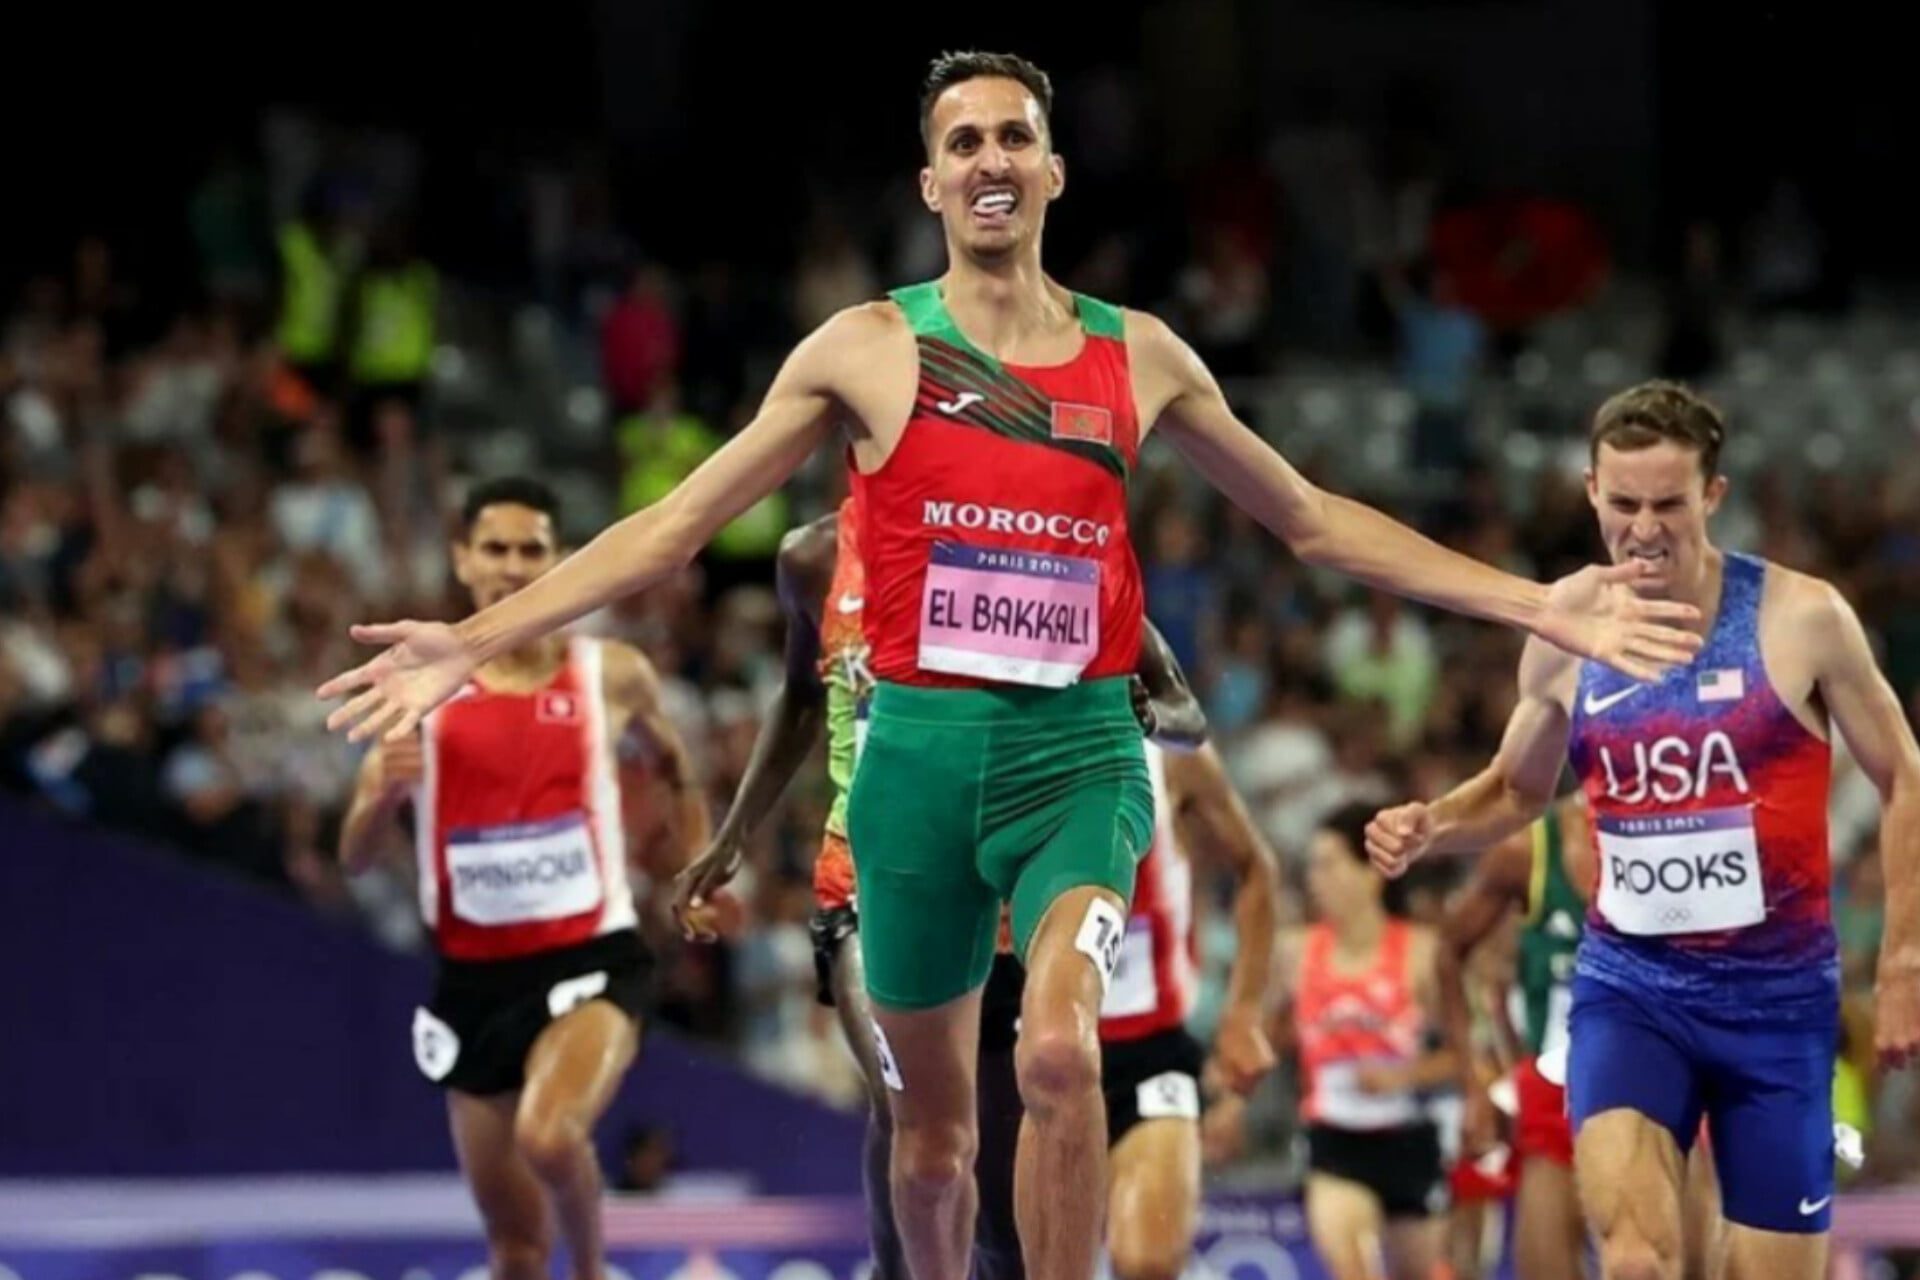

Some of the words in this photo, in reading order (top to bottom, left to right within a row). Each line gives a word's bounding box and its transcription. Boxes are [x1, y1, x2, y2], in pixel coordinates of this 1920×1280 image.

[922, 500, 1109, 546] MOROCCO
[977, 552, 1024, 571] PARIS
[929, 588, 962, 628] EL
[973, 594, 1089, 645] BAKKALI
[1600, 731, 1748, 803] USA
[1611, 851, 1747, 894] ROOKS
